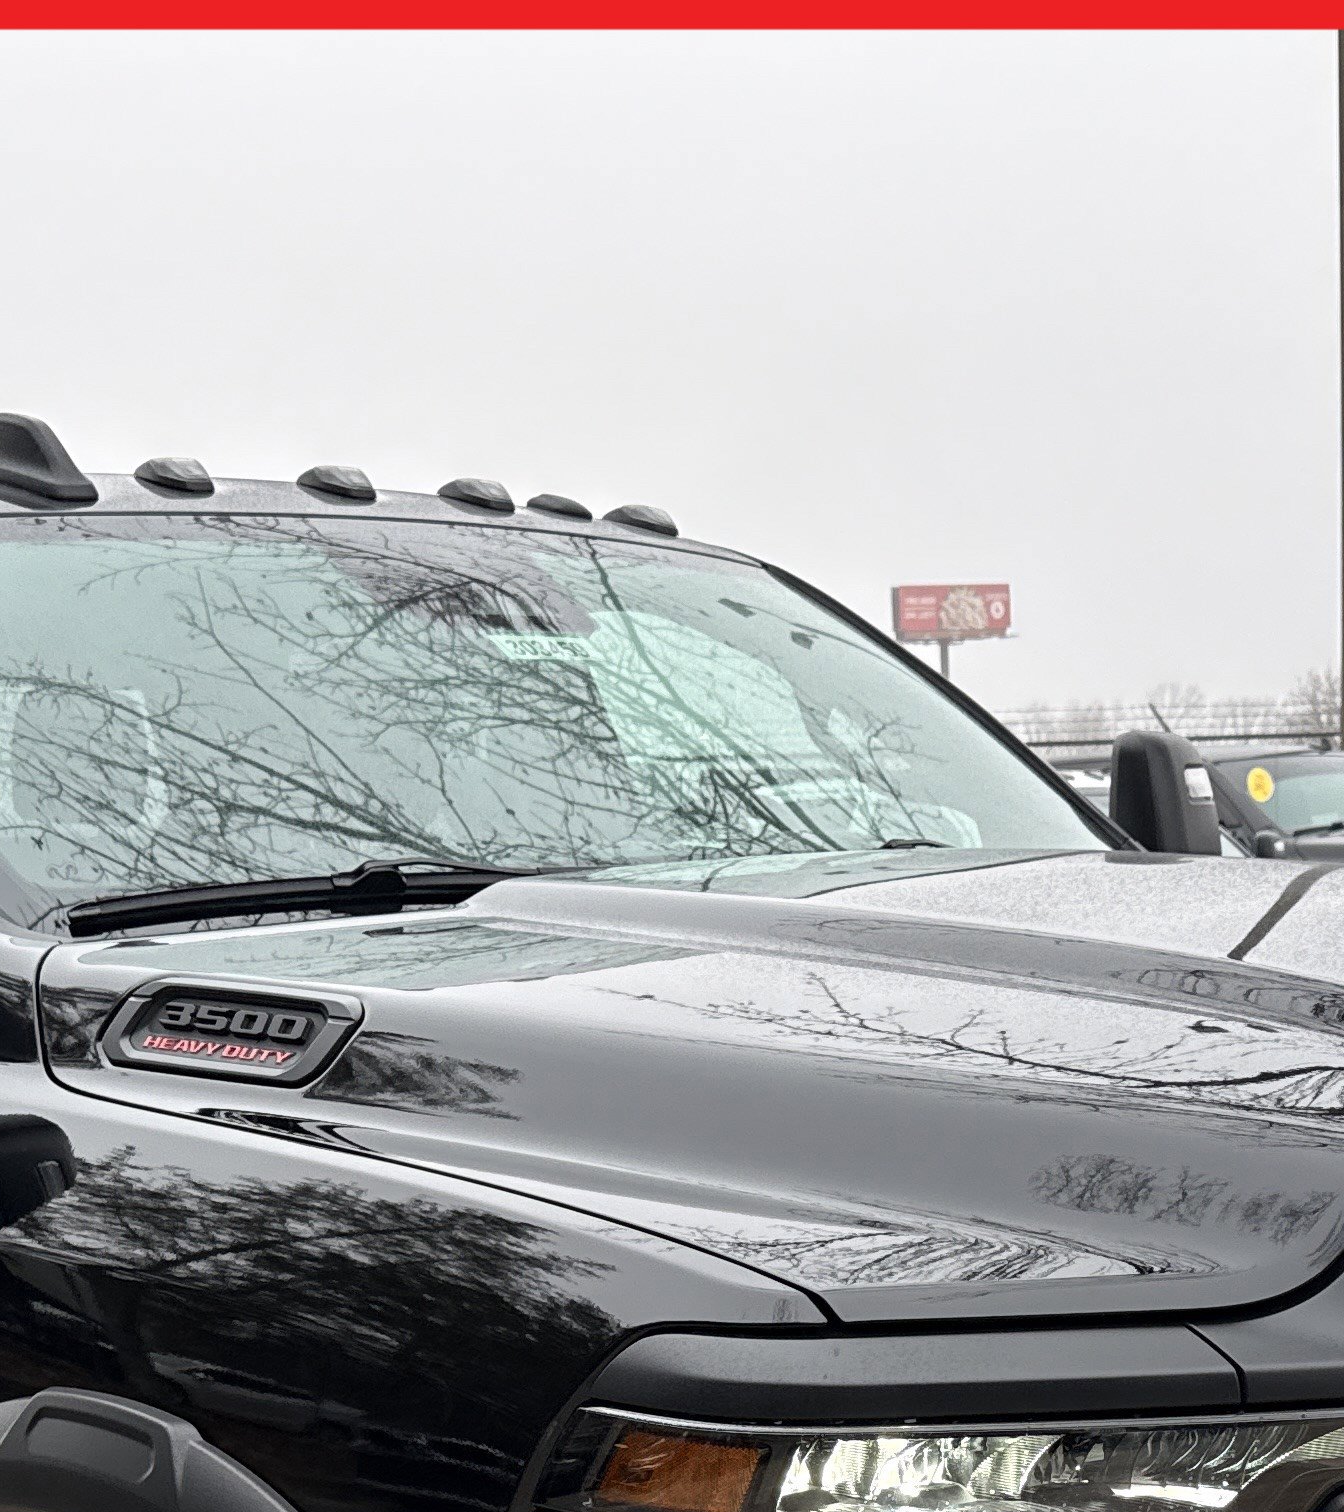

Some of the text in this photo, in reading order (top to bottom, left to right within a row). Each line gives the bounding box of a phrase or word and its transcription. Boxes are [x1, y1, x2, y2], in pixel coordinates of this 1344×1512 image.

[159, 1001, 312, 1043] 3500
[142, 1035, 293, 1065] HEAVY DUTY
